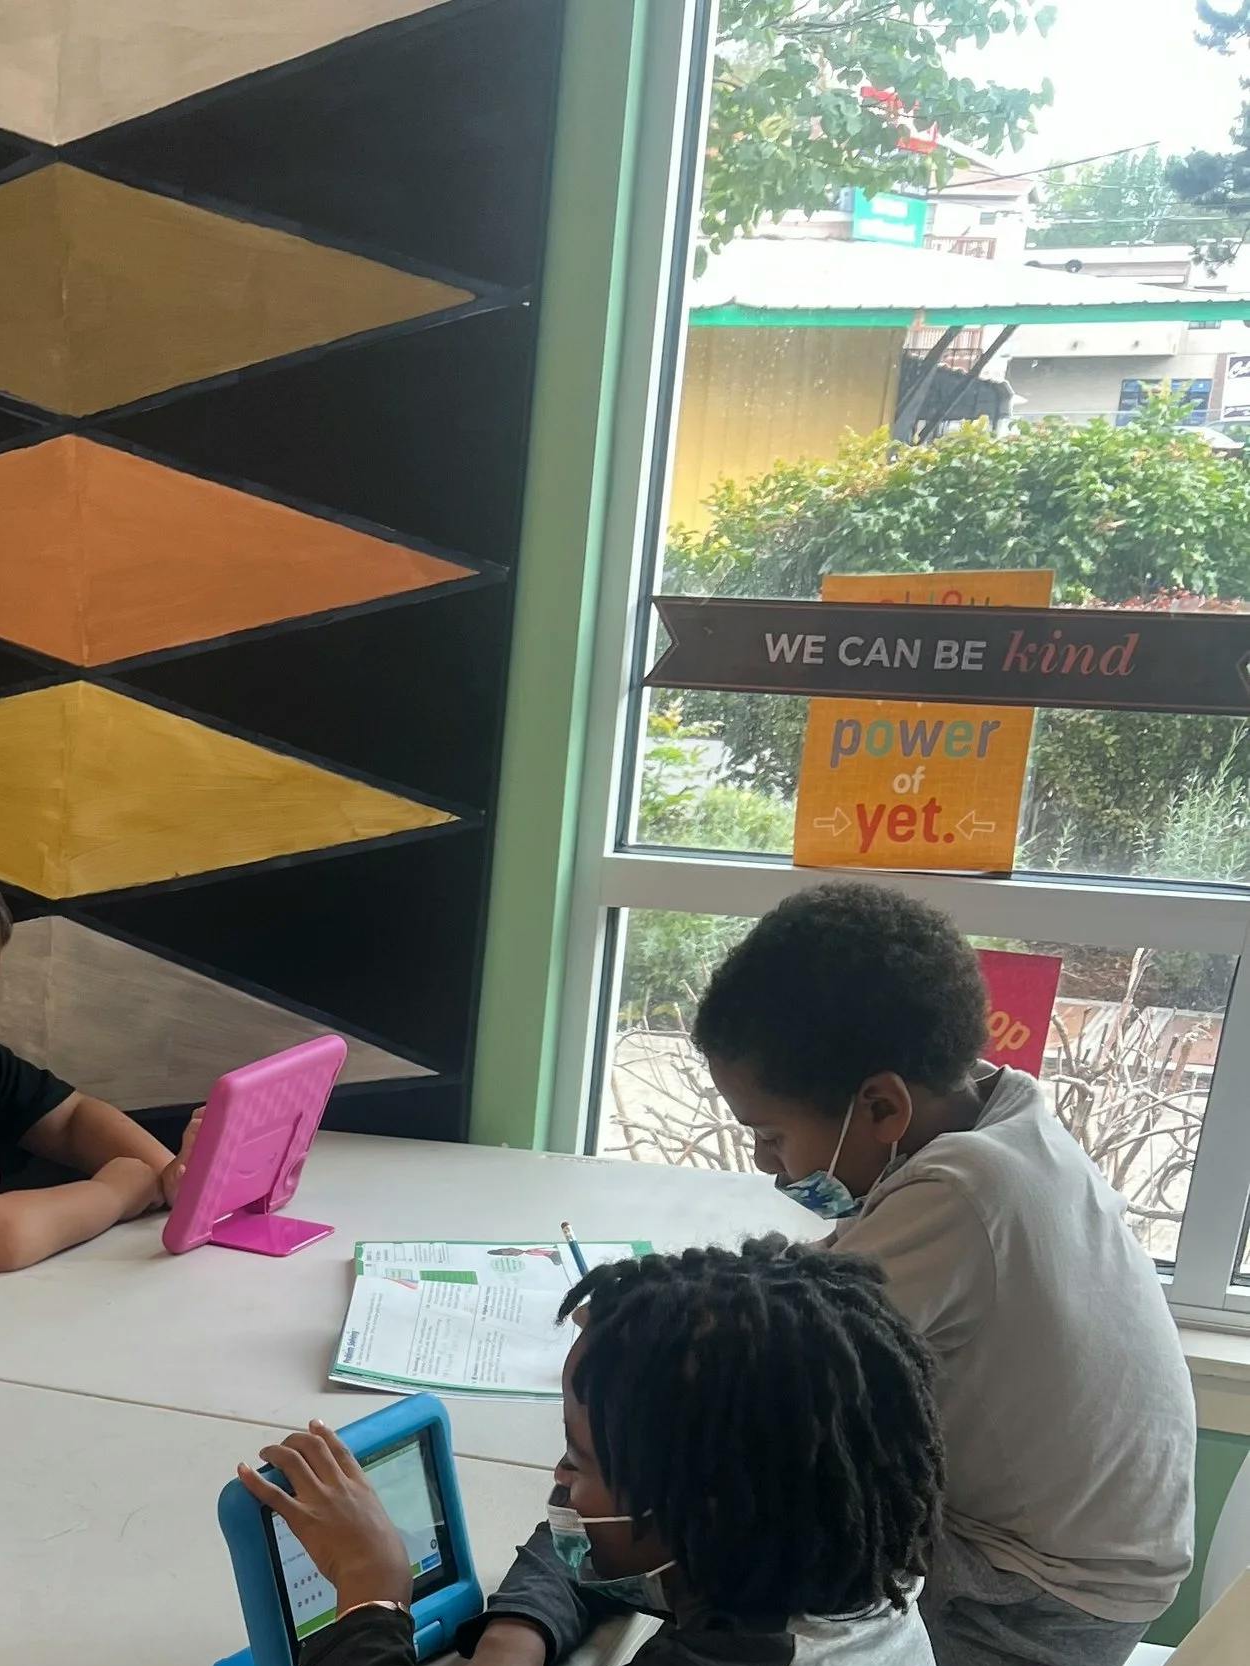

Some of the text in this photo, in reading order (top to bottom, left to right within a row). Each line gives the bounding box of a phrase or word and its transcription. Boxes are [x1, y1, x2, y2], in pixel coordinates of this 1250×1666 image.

[765, 629, 1140, 676] WE CAN BE kind
[830, 716, 1002, 768] power
[893, 766, 926, 795] of
[856, 797, 956, 854] yet.
